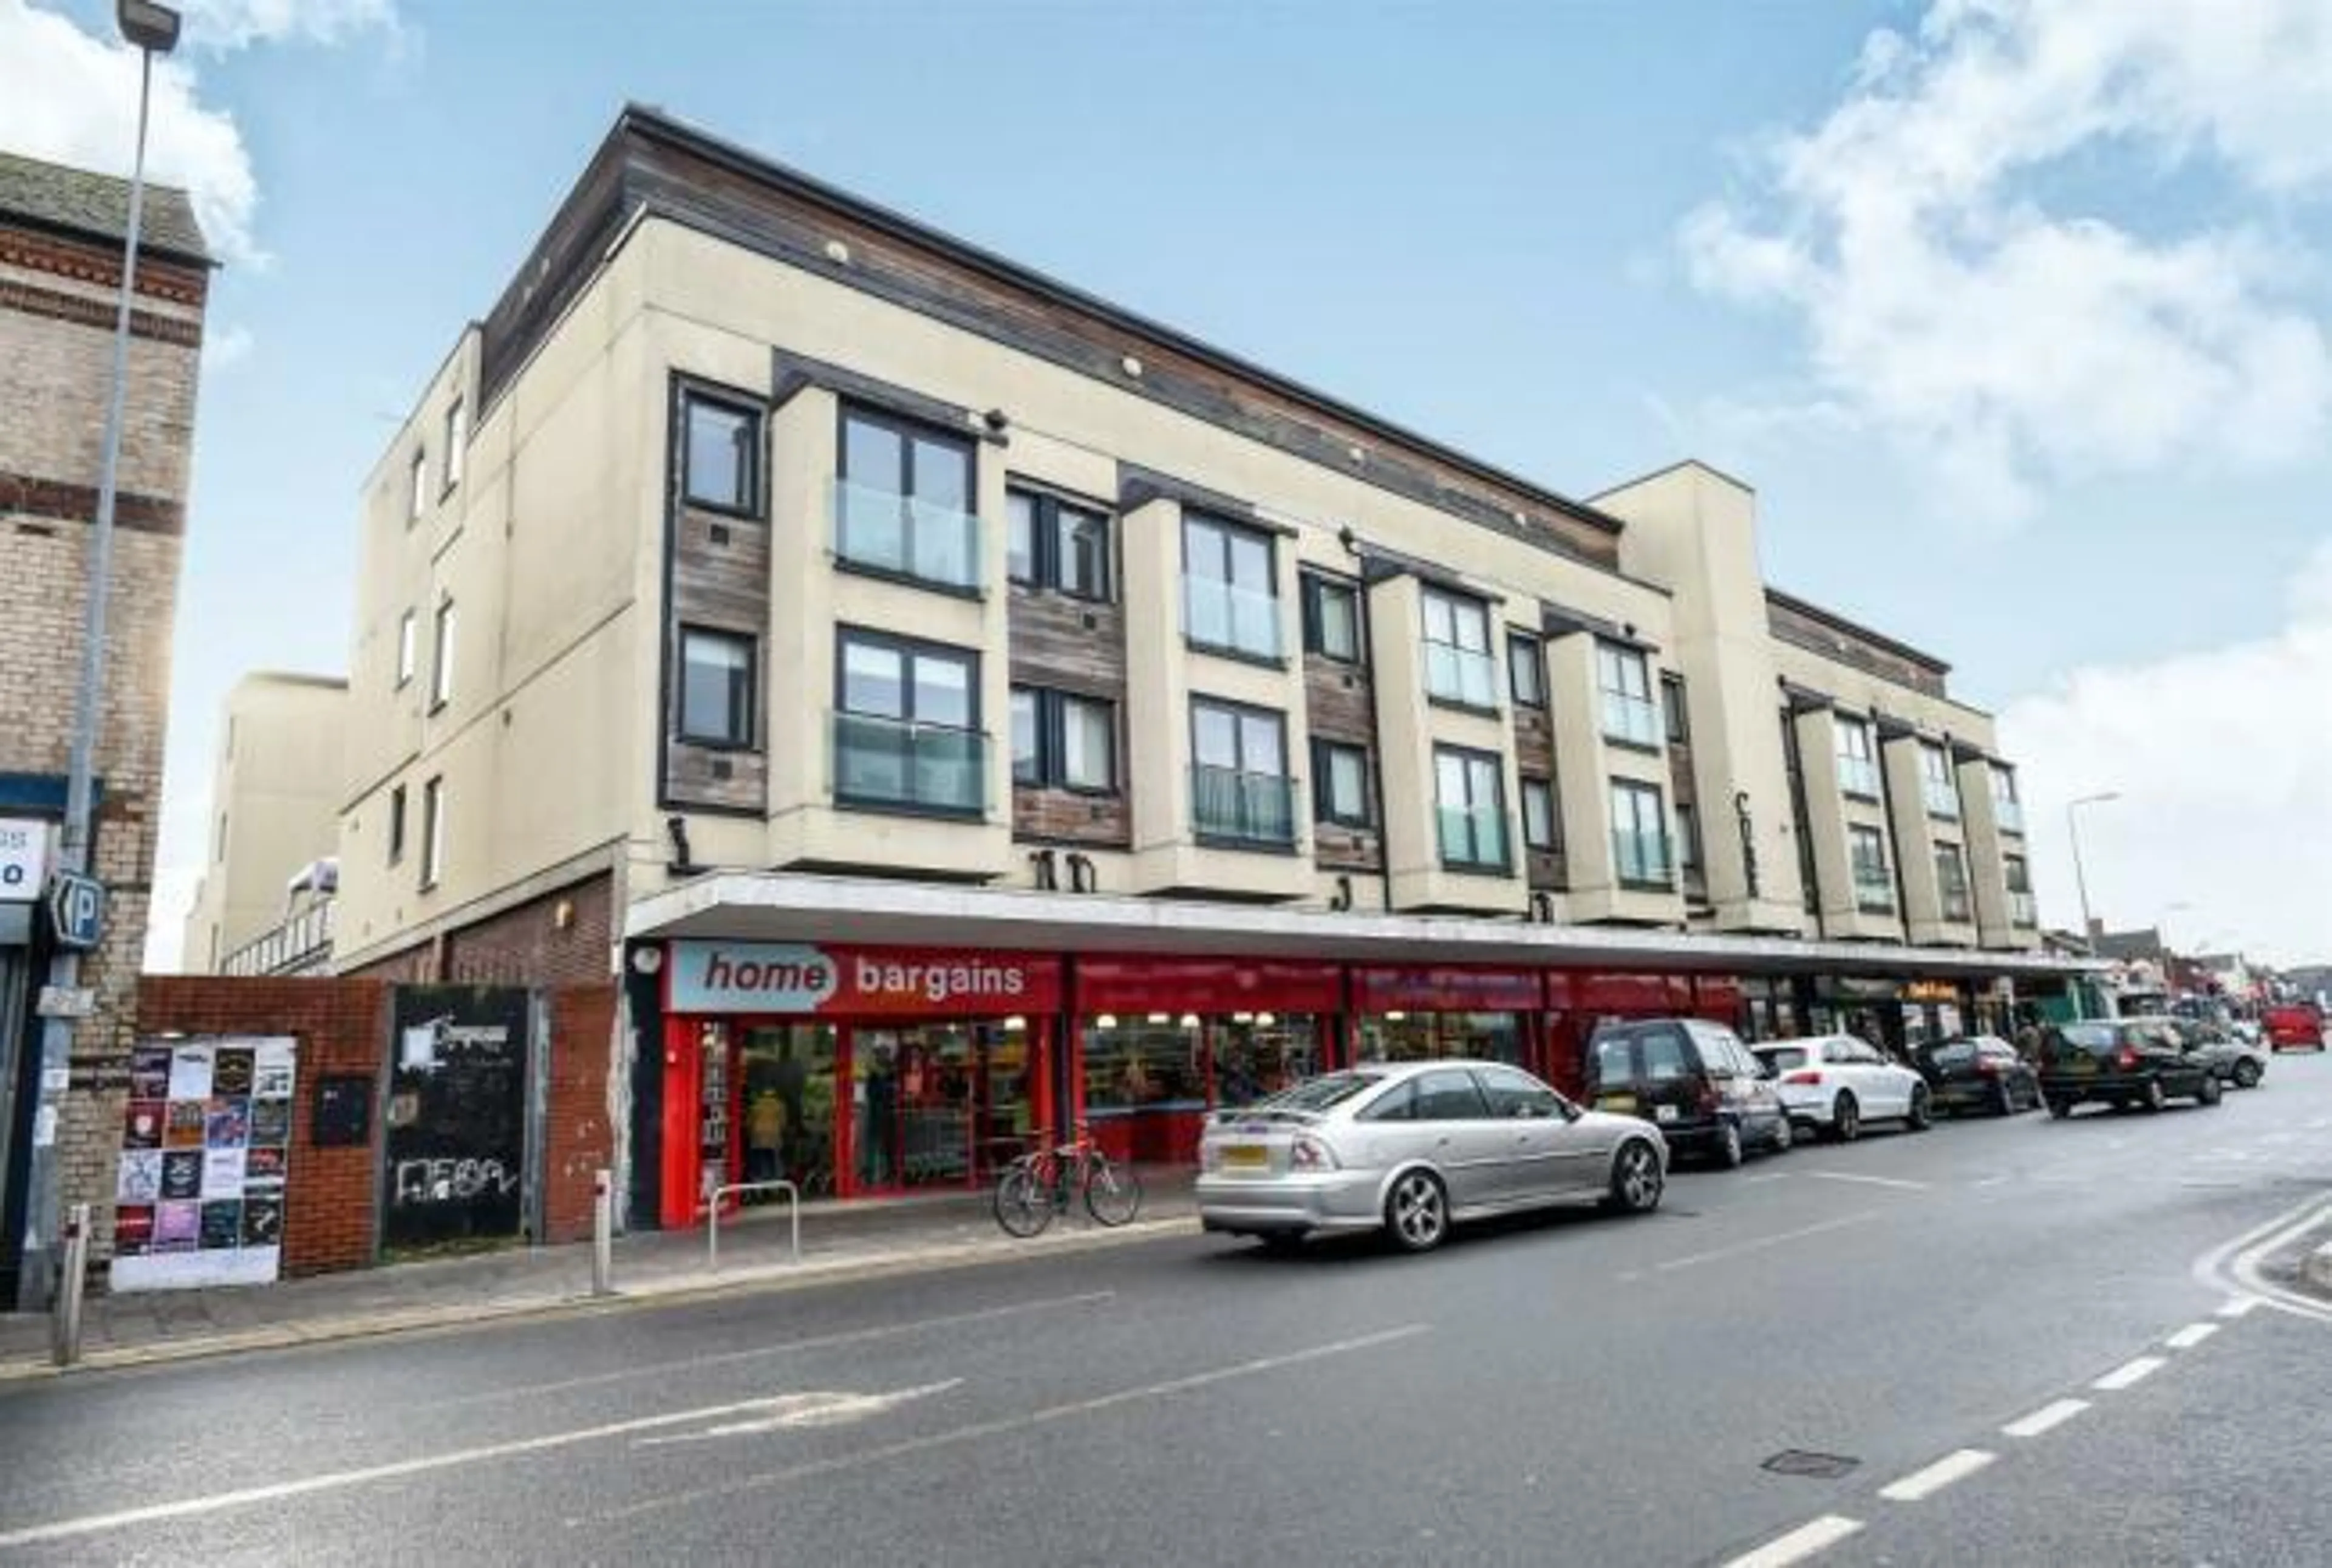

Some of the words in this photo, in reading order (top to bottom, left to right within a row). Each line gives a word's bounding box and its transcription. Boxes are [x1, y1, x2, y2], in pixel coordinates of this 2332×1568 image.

[76, 889, 95, 935] P
[704, 951, 827, 992] home
[856, 955, 1024, 1001] bargains
